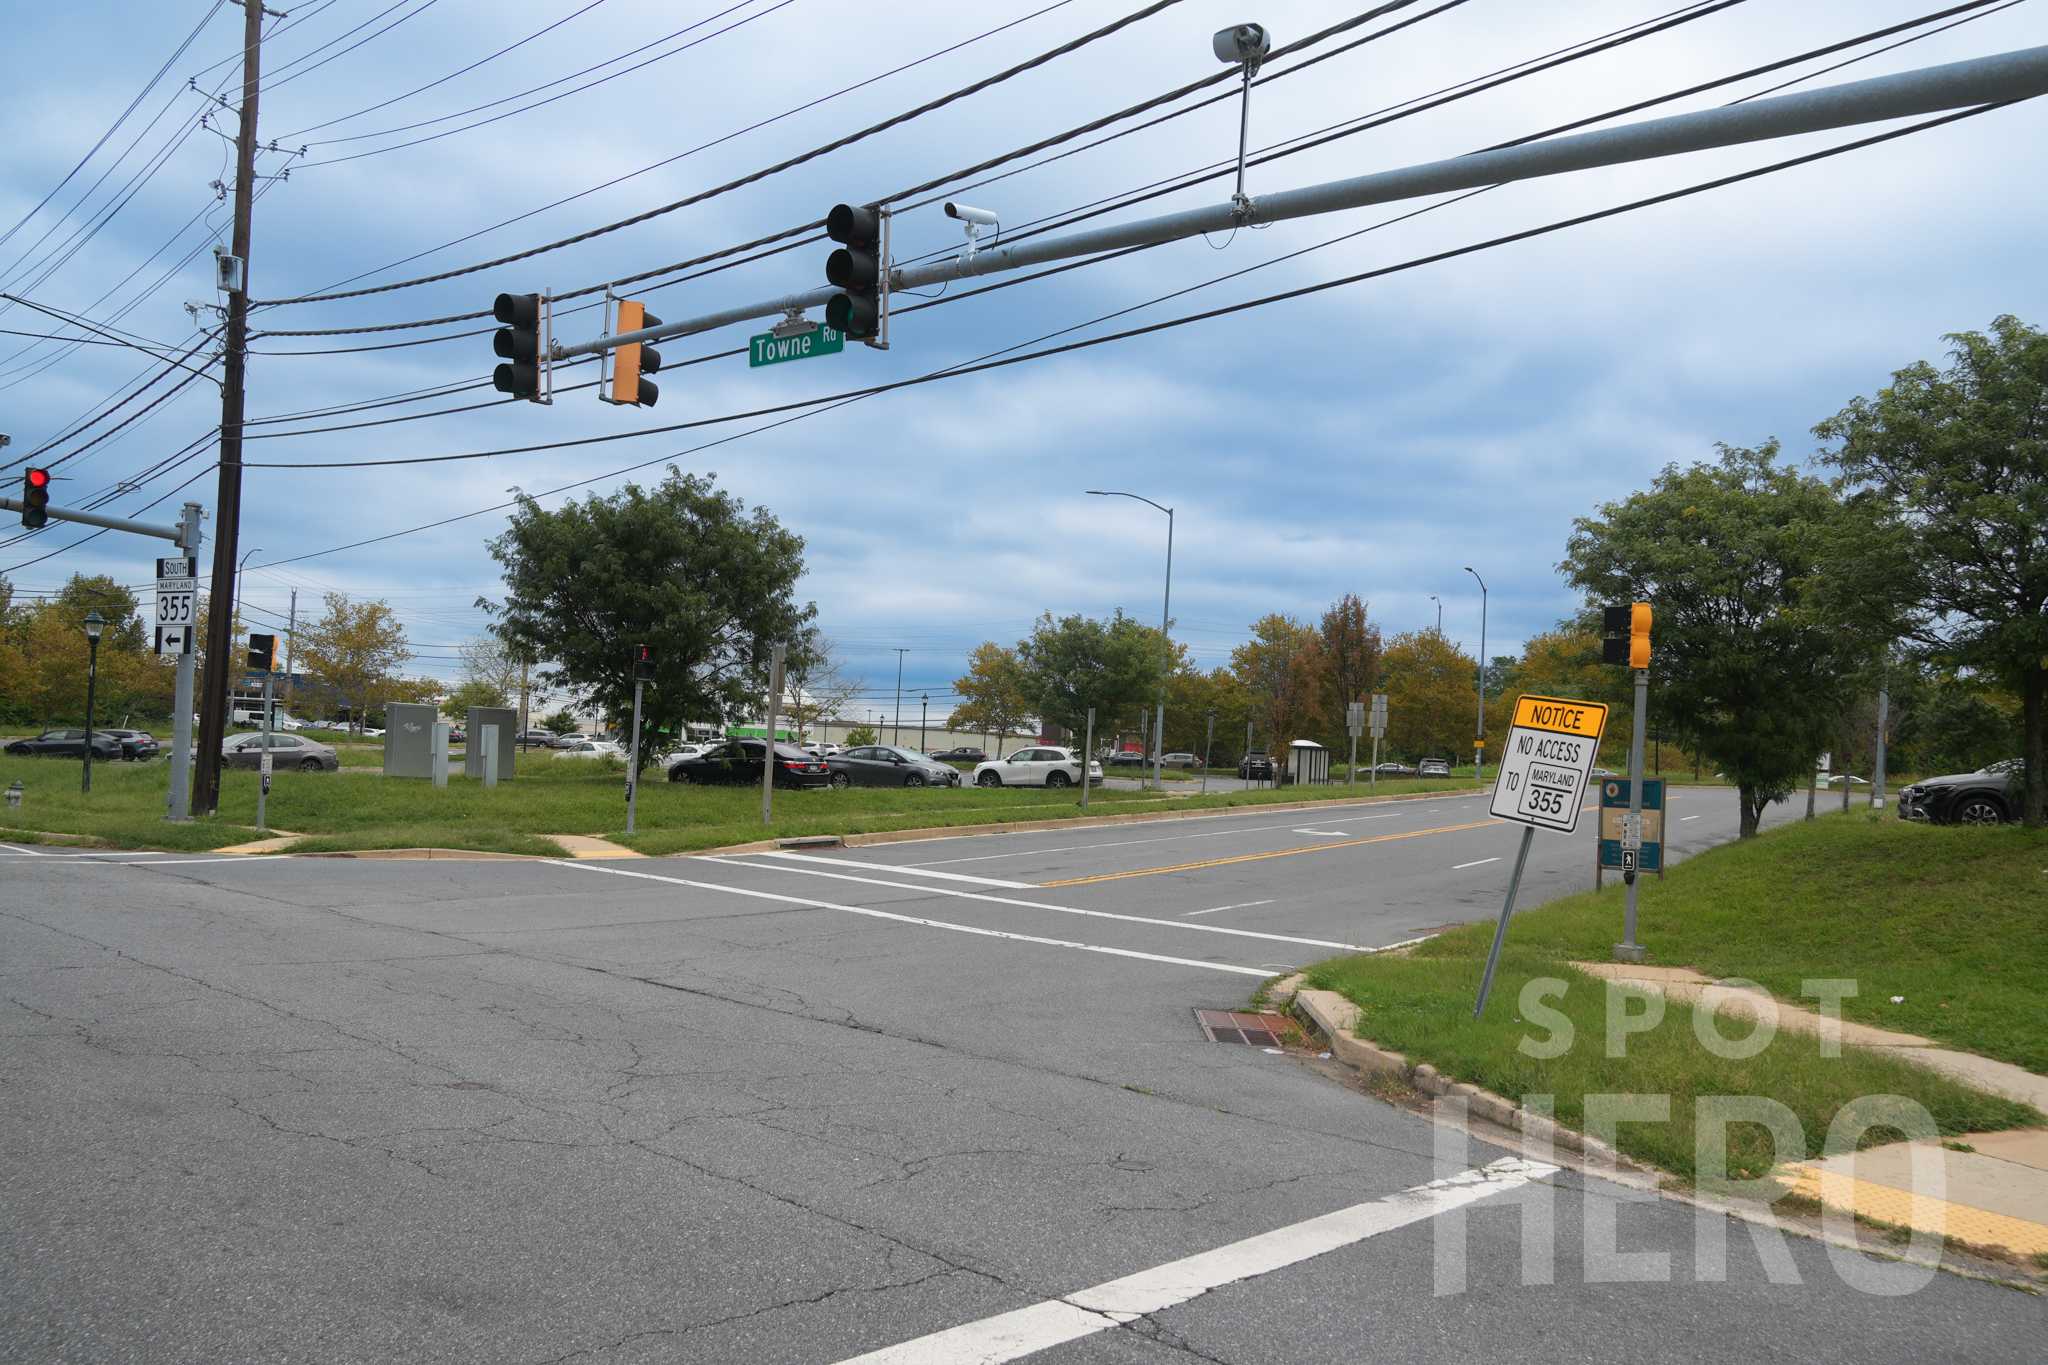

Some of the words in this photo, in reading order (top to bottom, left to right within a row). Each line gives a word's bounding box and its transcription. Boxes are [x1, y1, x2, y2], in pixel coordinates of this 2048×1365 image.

[756, 336, 811, 362] Towne
[165, 562, 187, 575] SOUTH
[160, 581, 192, 590] MARYLAND
[160, 596, 190, 621] 355
[1531, 705, 1584, 729] NOTICE
[1517, 736, 1533, 755] NO
[1535, 739, 1581, 763] ACCESS
[1506, 771, 1519, 791] TO
[1532, 769, 1574, 787] MARYLAND
[1529, 789, 1563, 814] 355
